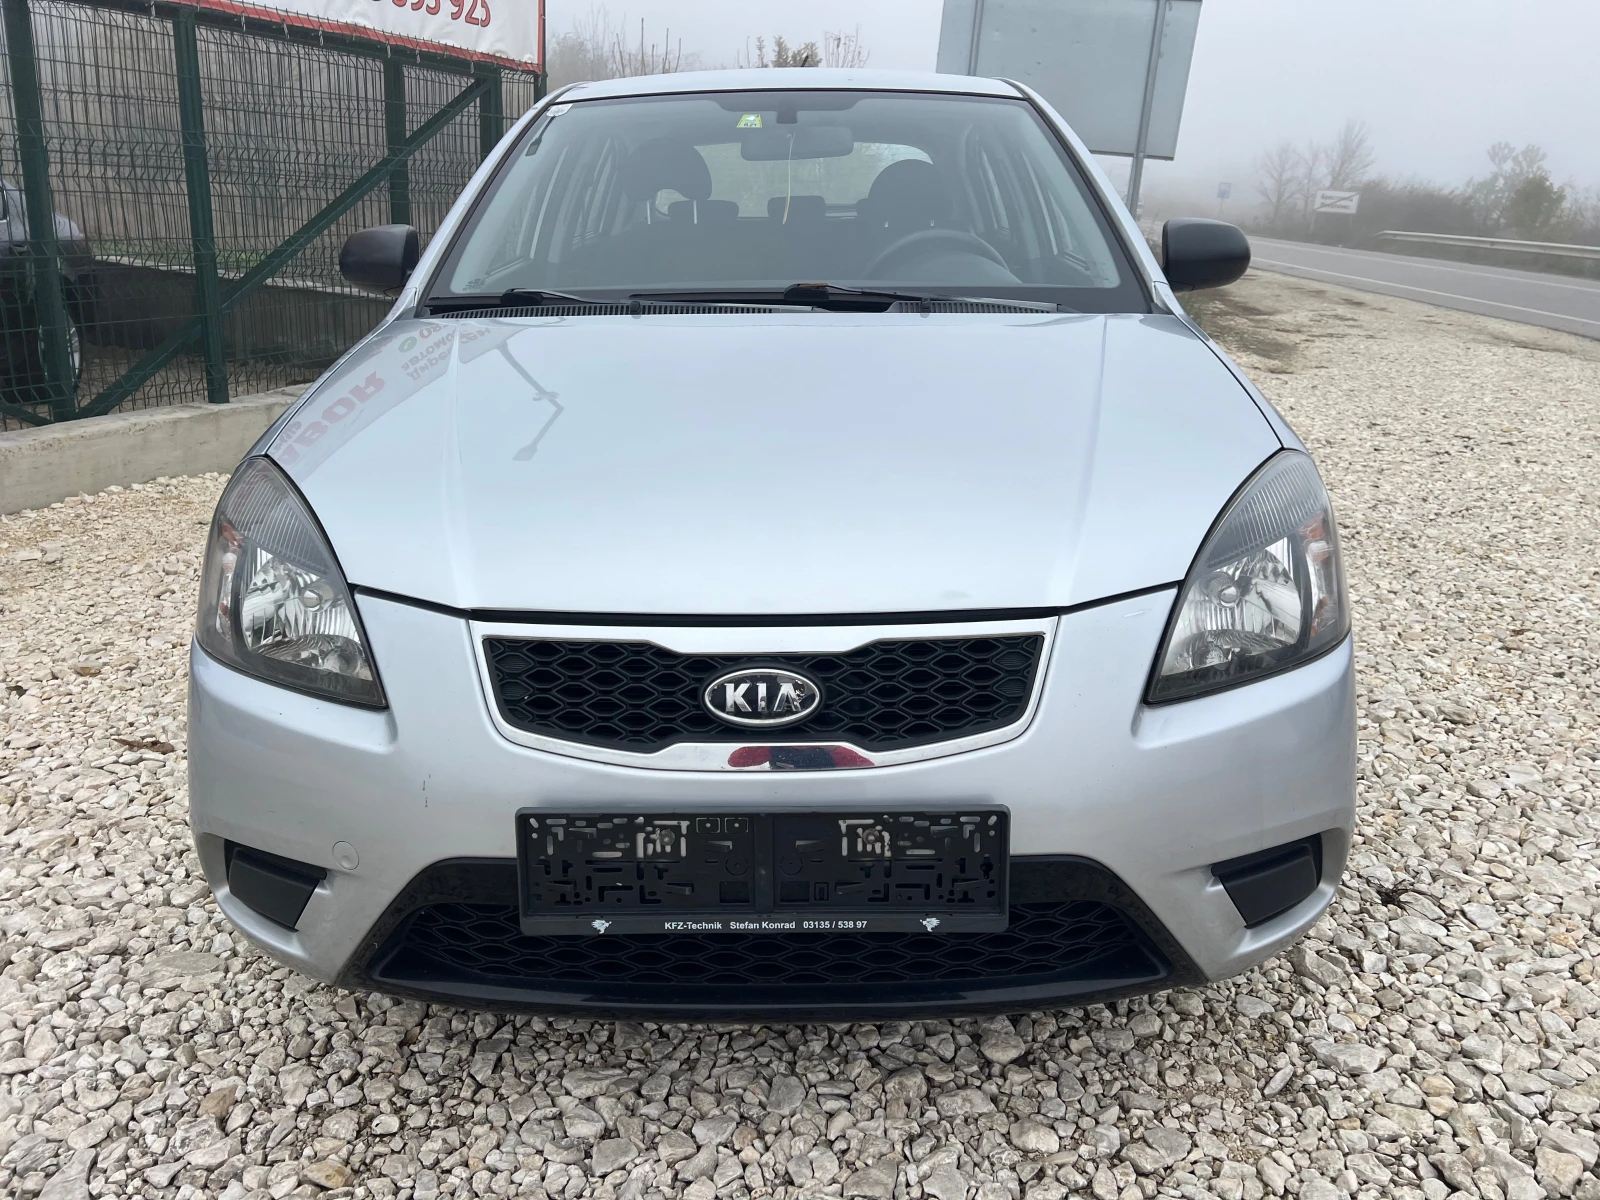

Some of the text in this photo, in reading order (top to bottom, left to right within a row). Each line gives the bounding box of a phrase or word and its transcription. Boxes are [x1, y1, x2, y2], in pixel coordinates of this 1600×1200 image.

[724, 683, 802, 712] KIA
[664, 921, 723, 930] KFZ-Technik
[729, 921, 760, 930] Stefan
[762, 921, 796, 930] Konrad
[803, 920, 830, 929] 03135
[838, 920, 854, 929] 538
[856, 920, 868, 929] 97
